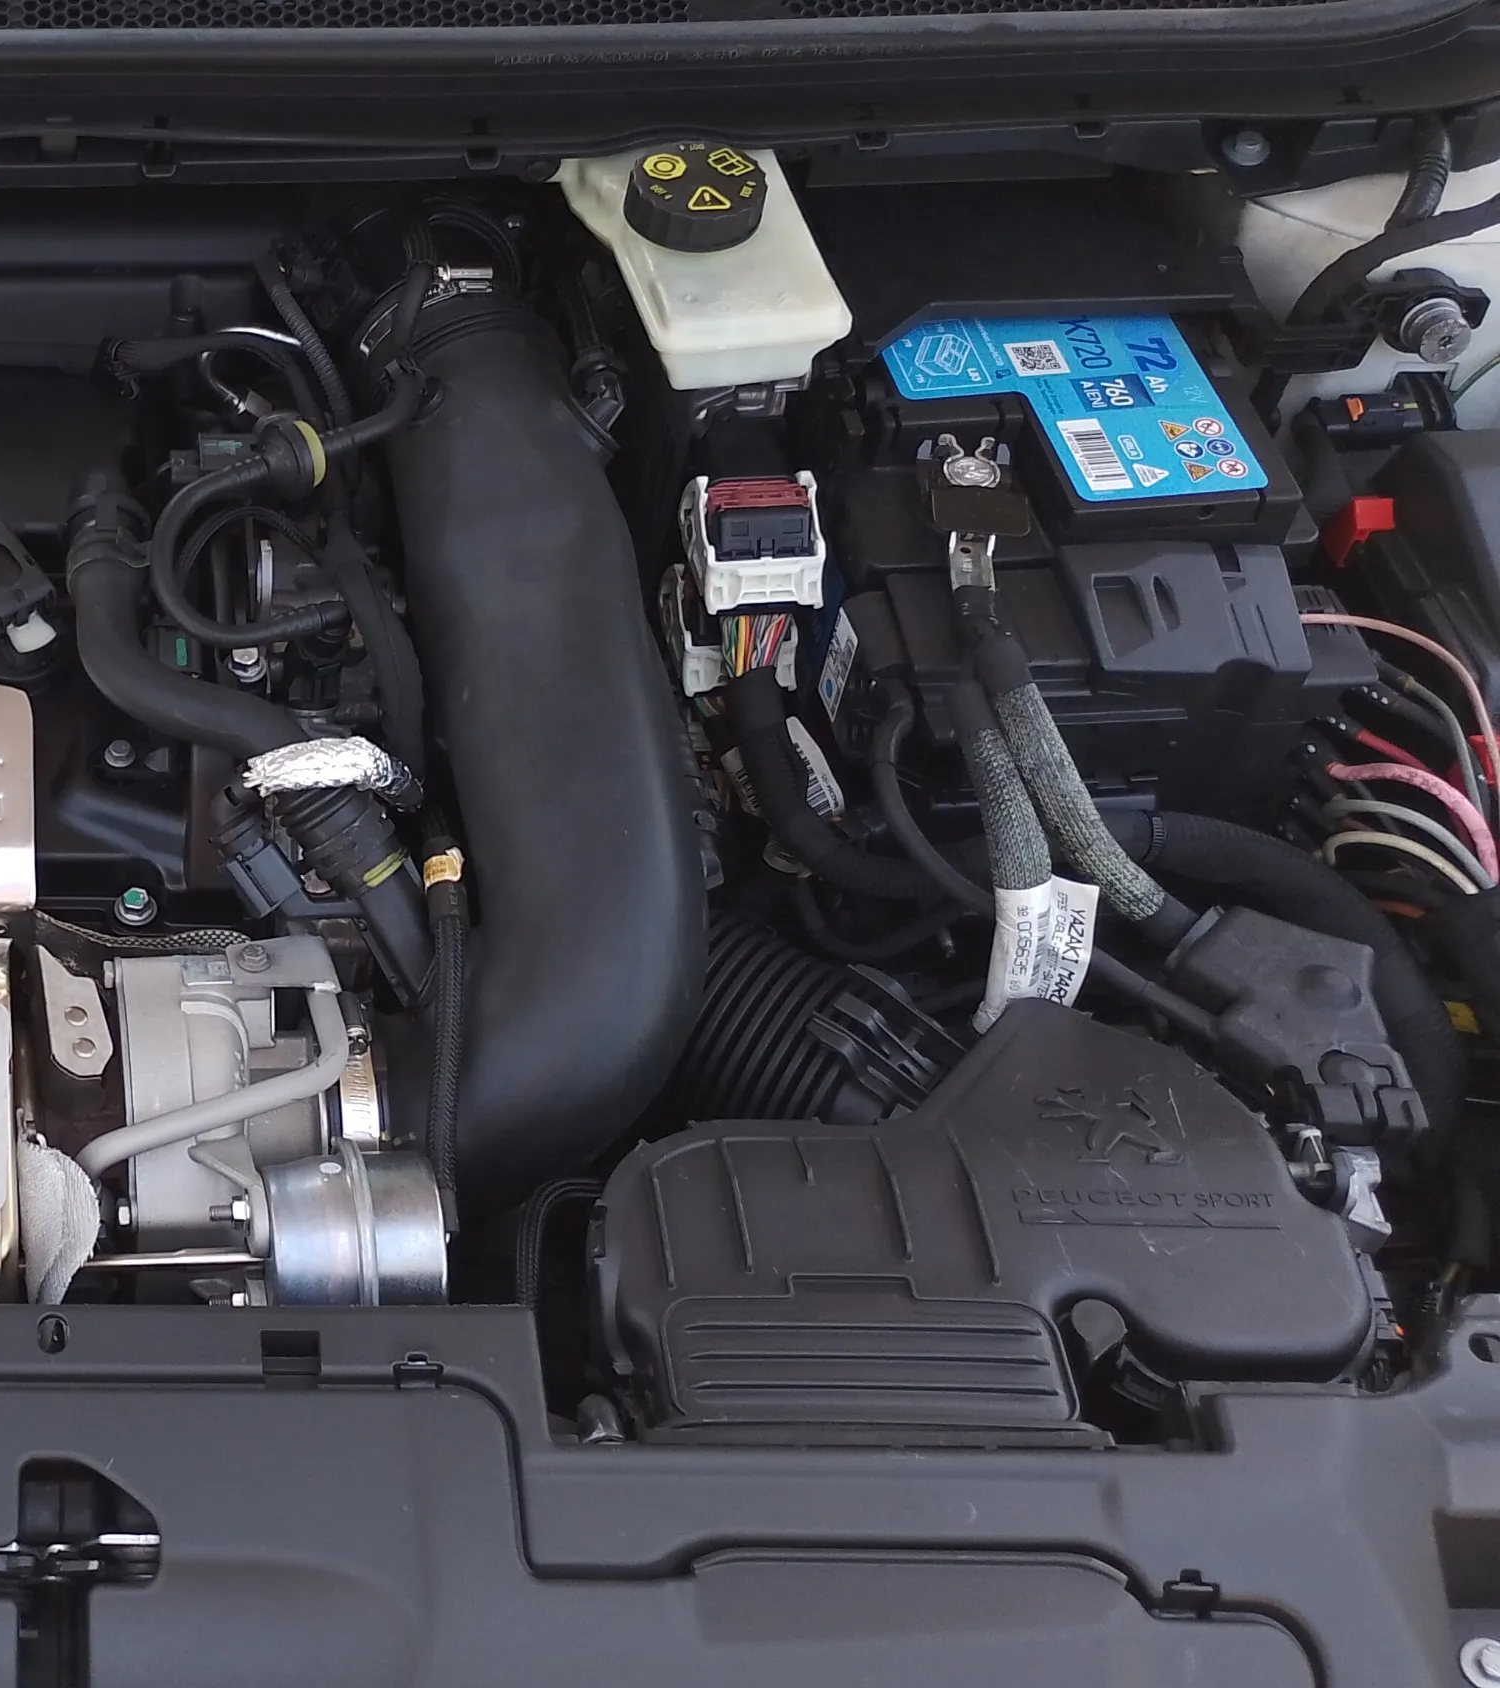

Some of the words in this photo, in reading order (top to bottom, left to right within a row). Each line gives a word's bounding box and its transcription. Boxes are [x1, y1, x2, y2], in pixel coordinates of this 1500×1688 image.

[1125, 337, 1177, 372] 72
[1100, 378, 1134, 406] 760
[1145, 375, 1170, 393] Ah
[1184, 385, 1208, 404] 12V
[1061, 908, 1086, 965] YAZAKI
[1011, 1188, 1188, 1207] PEUGEOT
[1193, 1192, 1275, 1208] SPORT
